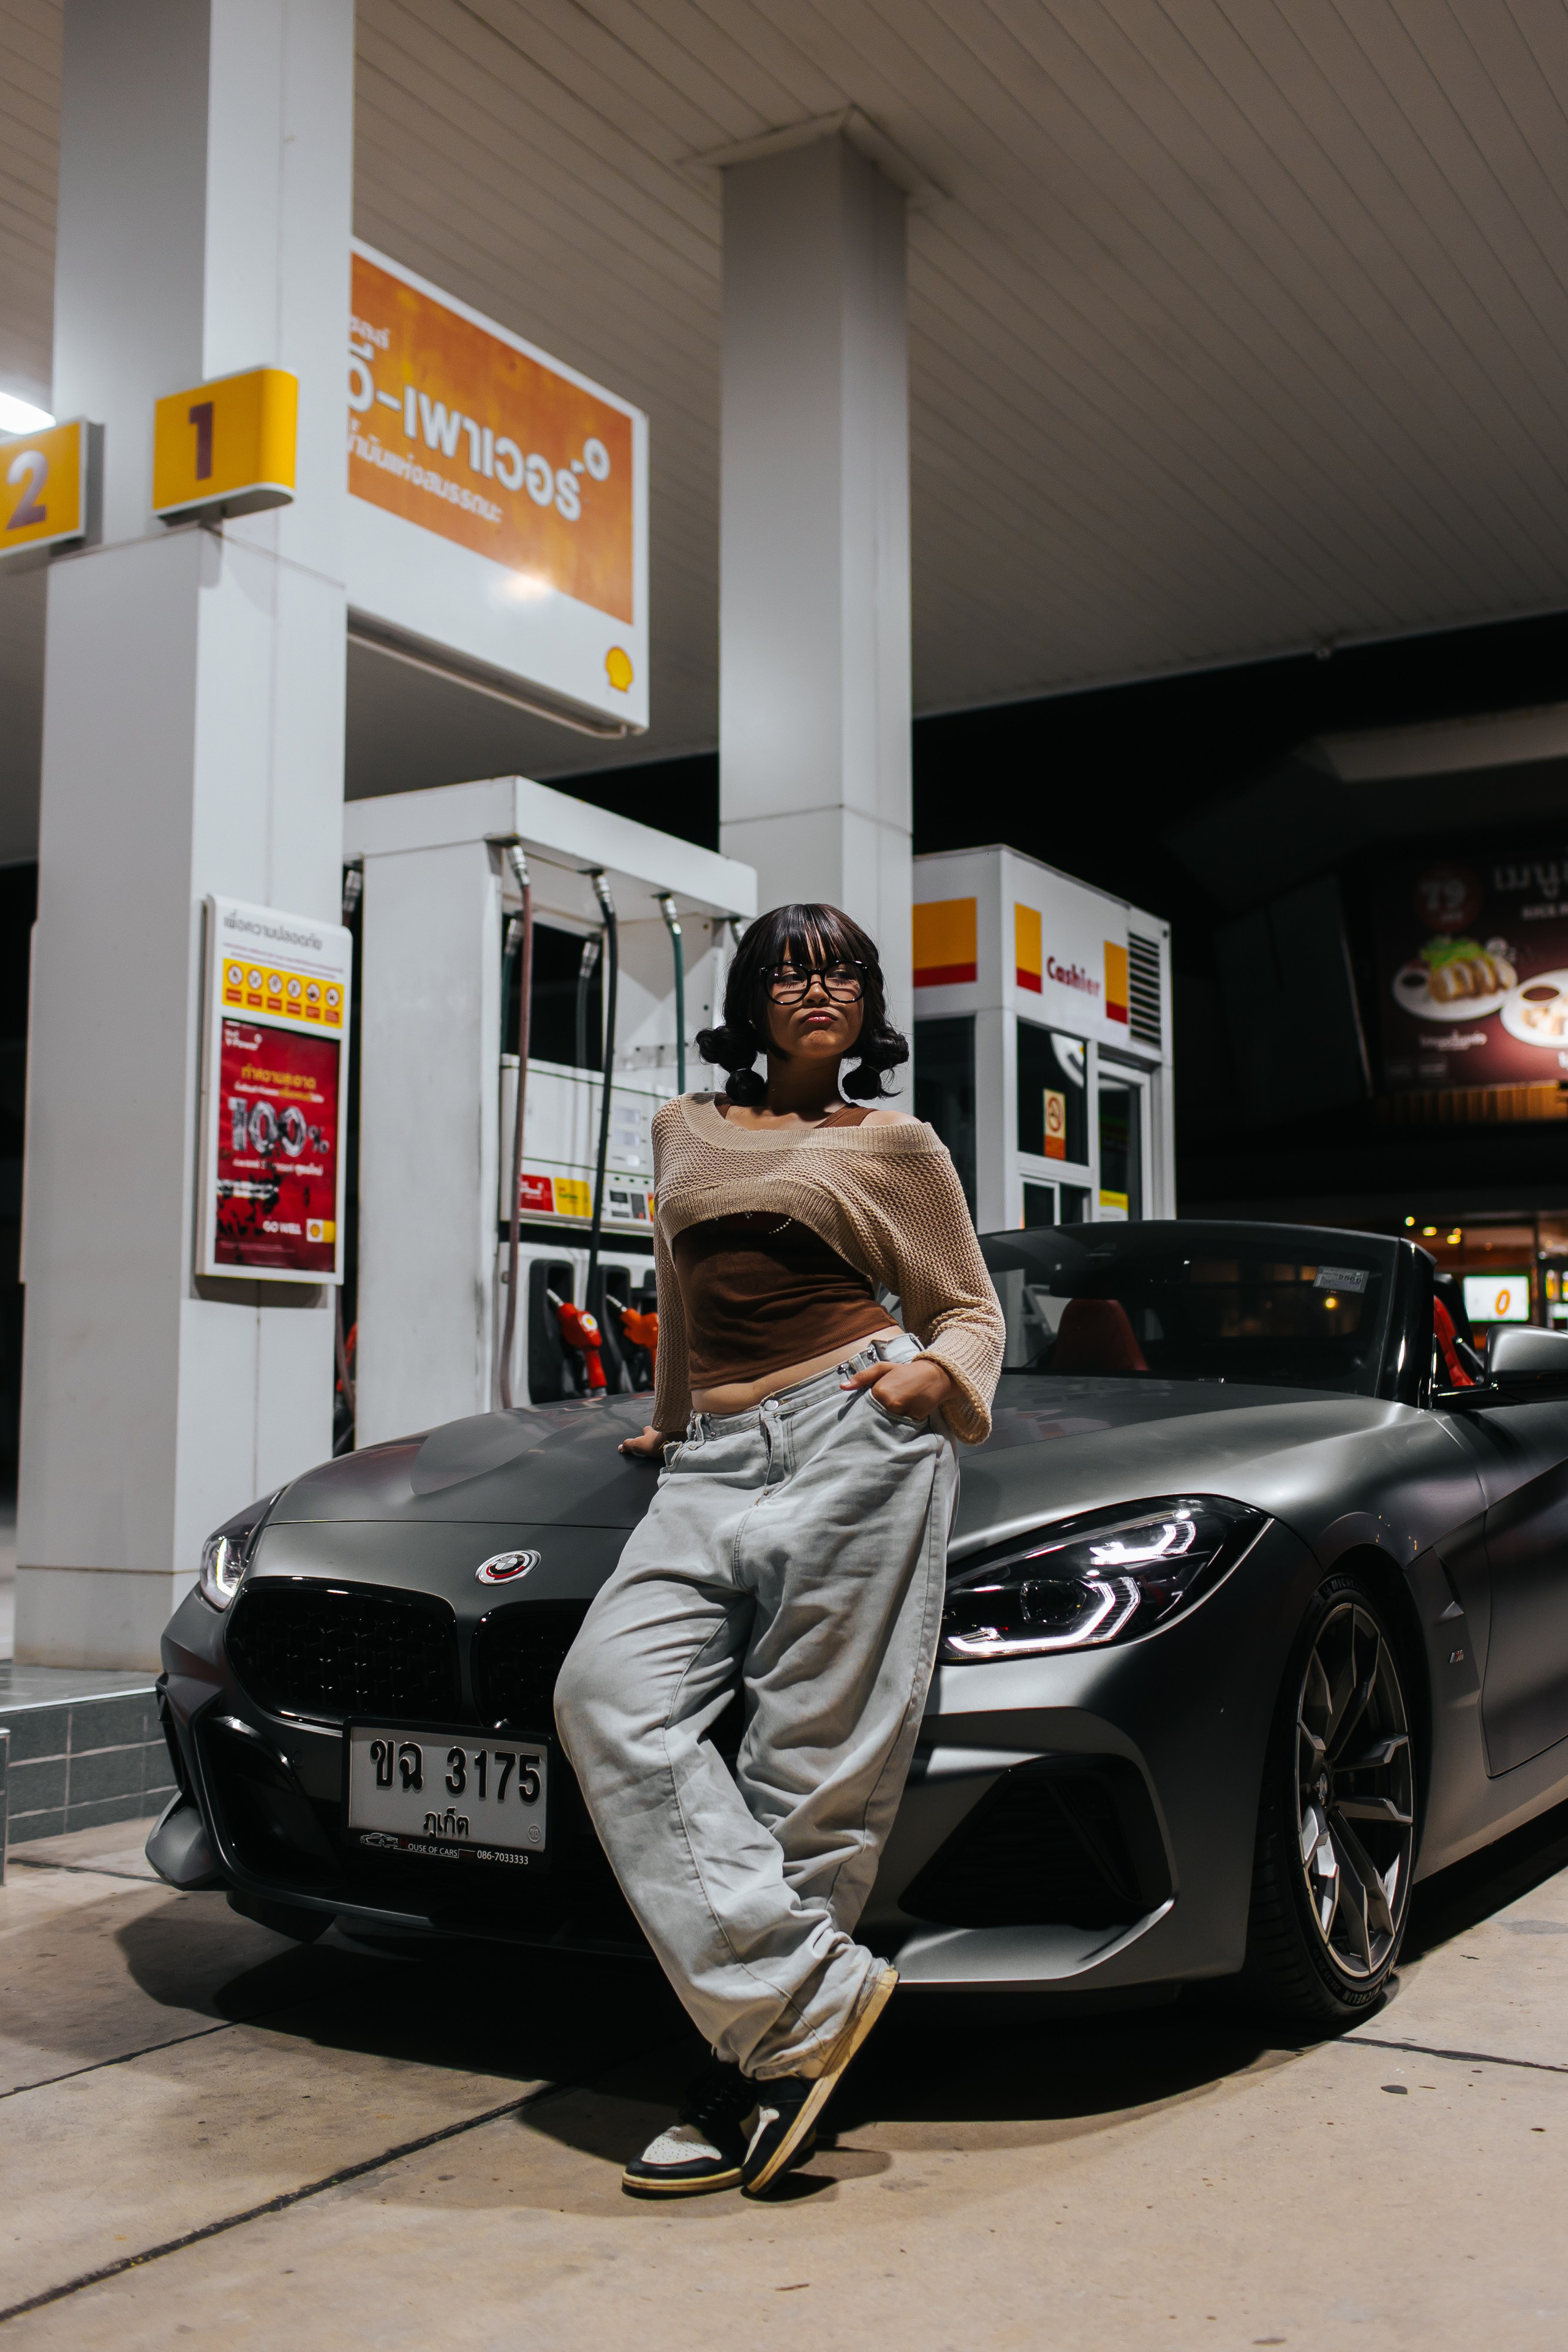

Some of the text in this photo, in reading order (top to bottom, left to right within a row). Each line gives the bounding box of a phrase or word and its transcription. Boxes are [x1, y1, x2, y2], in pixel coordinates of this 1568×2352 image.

[188, 401, 214, 481] 1
[6, 450, 48, 531] 2
[1046, 956, 1100, 997] Cashier
[227, 1097, 330, 1157] 100%
[370, 1738, 542, 1803] ขฉ 3175
[423, 1806, 470, 1838] ภูเก็ต
[439, 1849, 458, 1857] CARS
[477, 1850, 529, 1865] 086-7033333
[1342, 1983, 1382, 2004] MICHELIN
